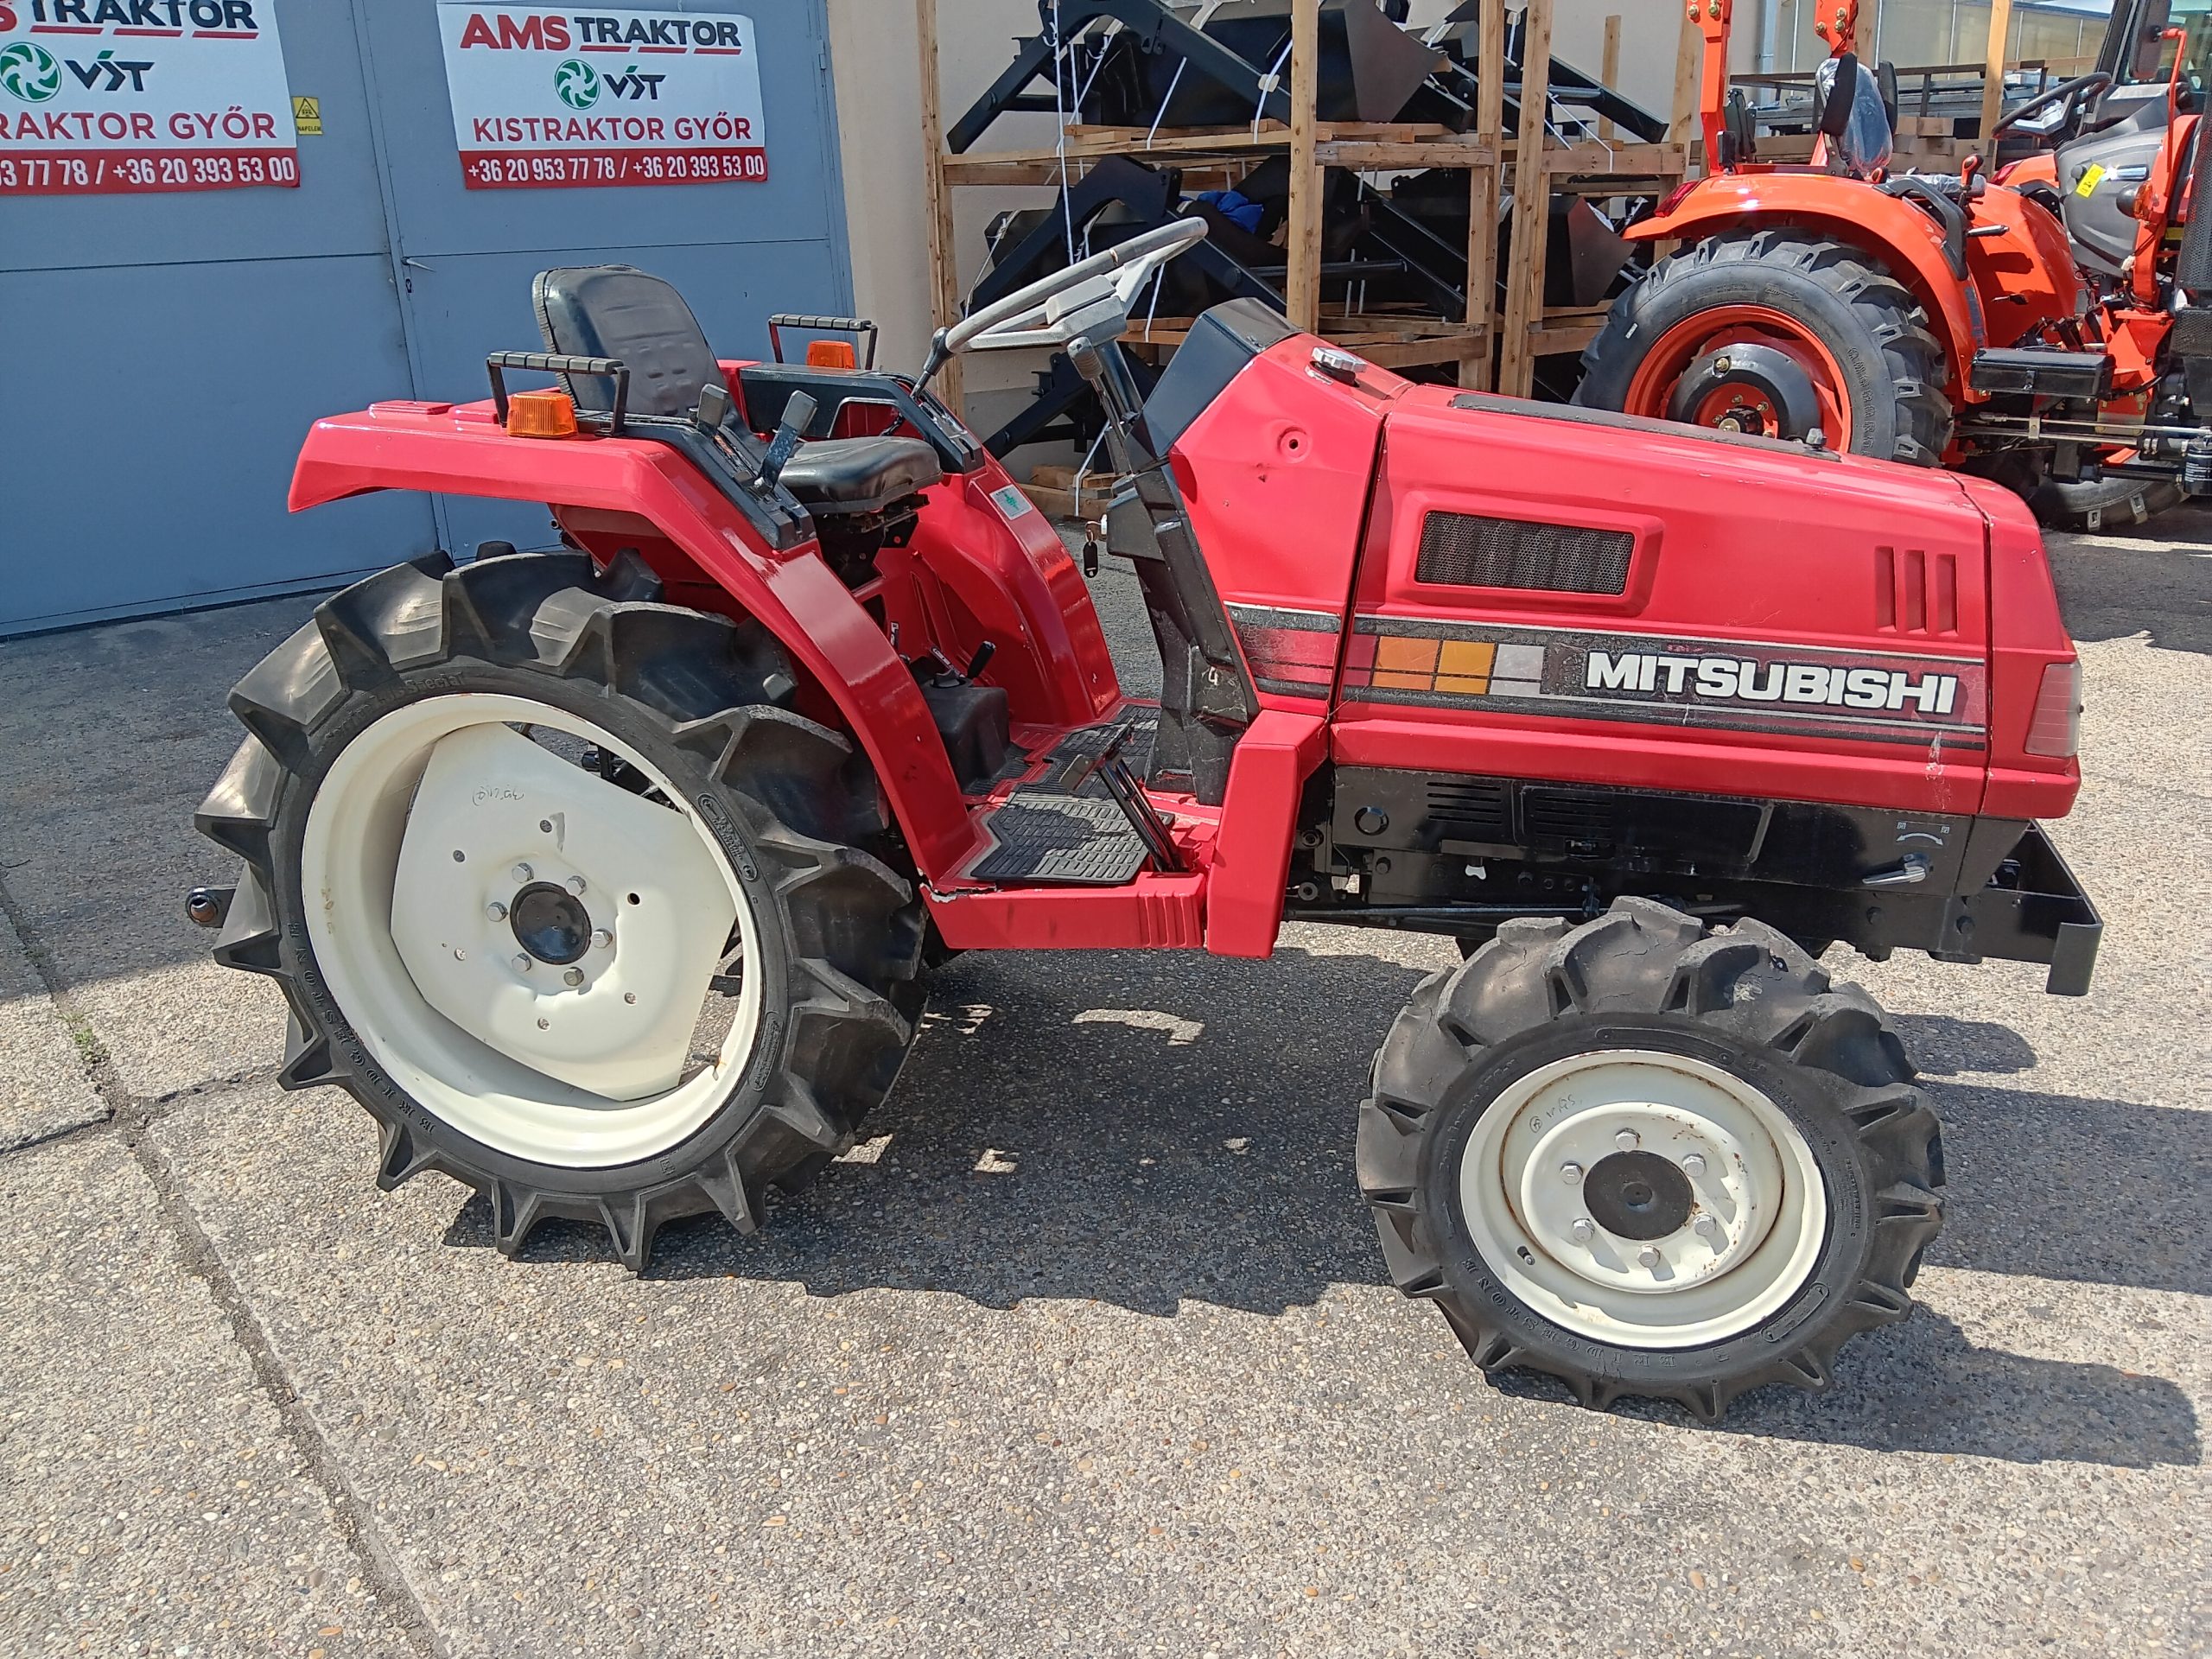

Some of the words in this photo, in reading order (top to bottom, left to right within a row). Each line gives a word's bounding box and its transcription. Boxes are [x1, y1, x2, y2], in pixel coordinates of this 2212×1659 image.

[168, 105, 277, 139] GYŐR
[473, 117, 664, 142] KISTRAKTOR
[674, 111, 751, 140] GYŐR
[21, 159, 50, 186] 77
[56, 159, 89, 186] 78
[112, 158, 156, 184] +36
[160, 158, 188, 183] 20
[192, 157, 233, 182] 393
[238, 156, 264, 181] 53
[268, 156, 295, 181] 00
[468, 158, 503, 182] +36
[505, 158, 529, 181] 20
[532, 158, 565, 181] 953
[568, 157, 588, 180] 77
[594, 157, 615, 179] 78
[633, 156, 663, 178] +36
[667, 156, 687, 177] 20
[690, 156, 719, 177] 393
[722, 156, 741, 176] 53
[746, 155, 764, 175] 00
[1586, 651, 1958, 714] MITSUBISHI
[288, 921, 435, 1134] BRIDGESTONE
[1459, 1257, 1676, 1369] BRIDGESTONE
